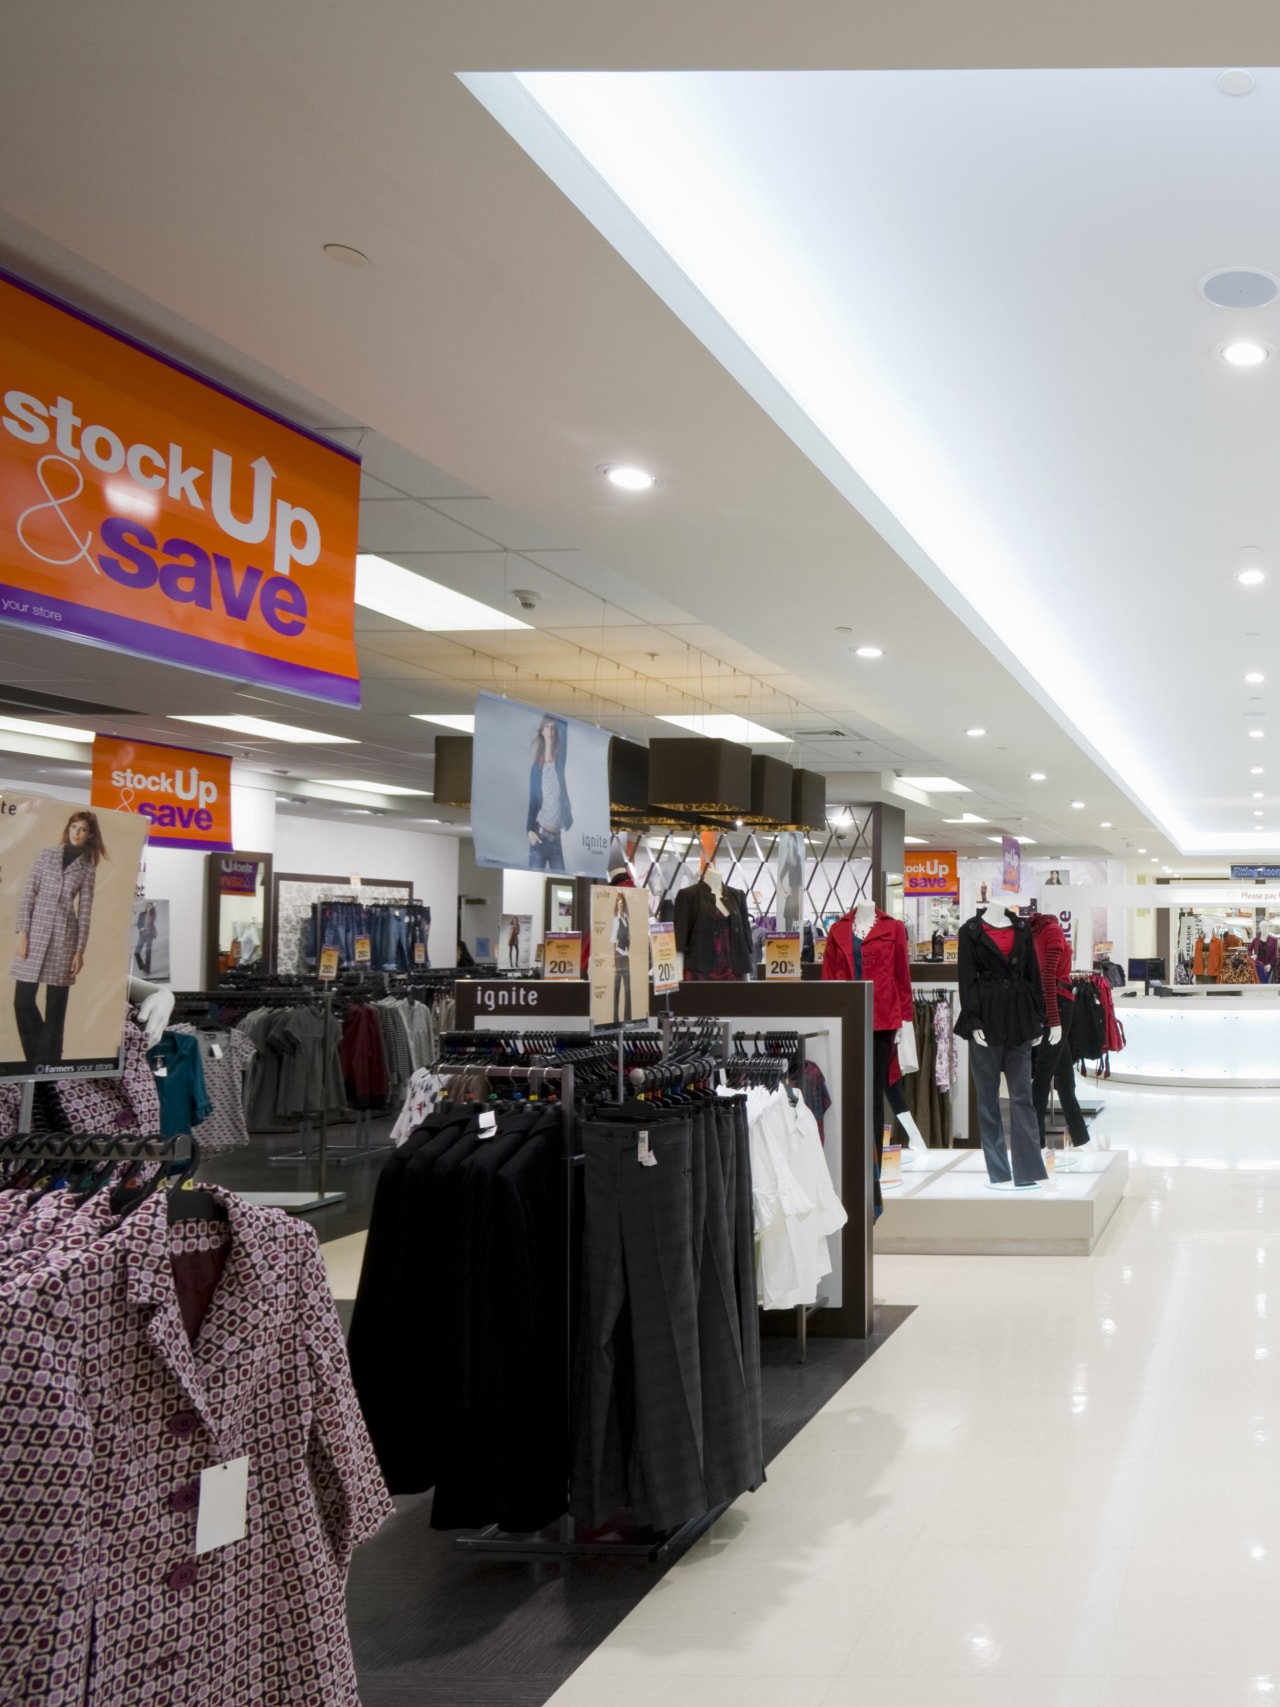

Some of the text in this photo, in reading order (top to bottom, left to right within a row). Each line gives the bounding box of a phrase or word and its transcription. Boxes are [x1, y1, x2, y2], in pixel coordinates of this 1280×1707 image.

[17, 455, 308, 637] & save
[1, 598, 63, 621] your store
[138, 802, 213, 831] save
[582, 833, 608, 851] ignite
[909, 877, 947, 888] save
[1241, 892, 1263, 900] Please
[477, 986, 538, 1011] ignite
